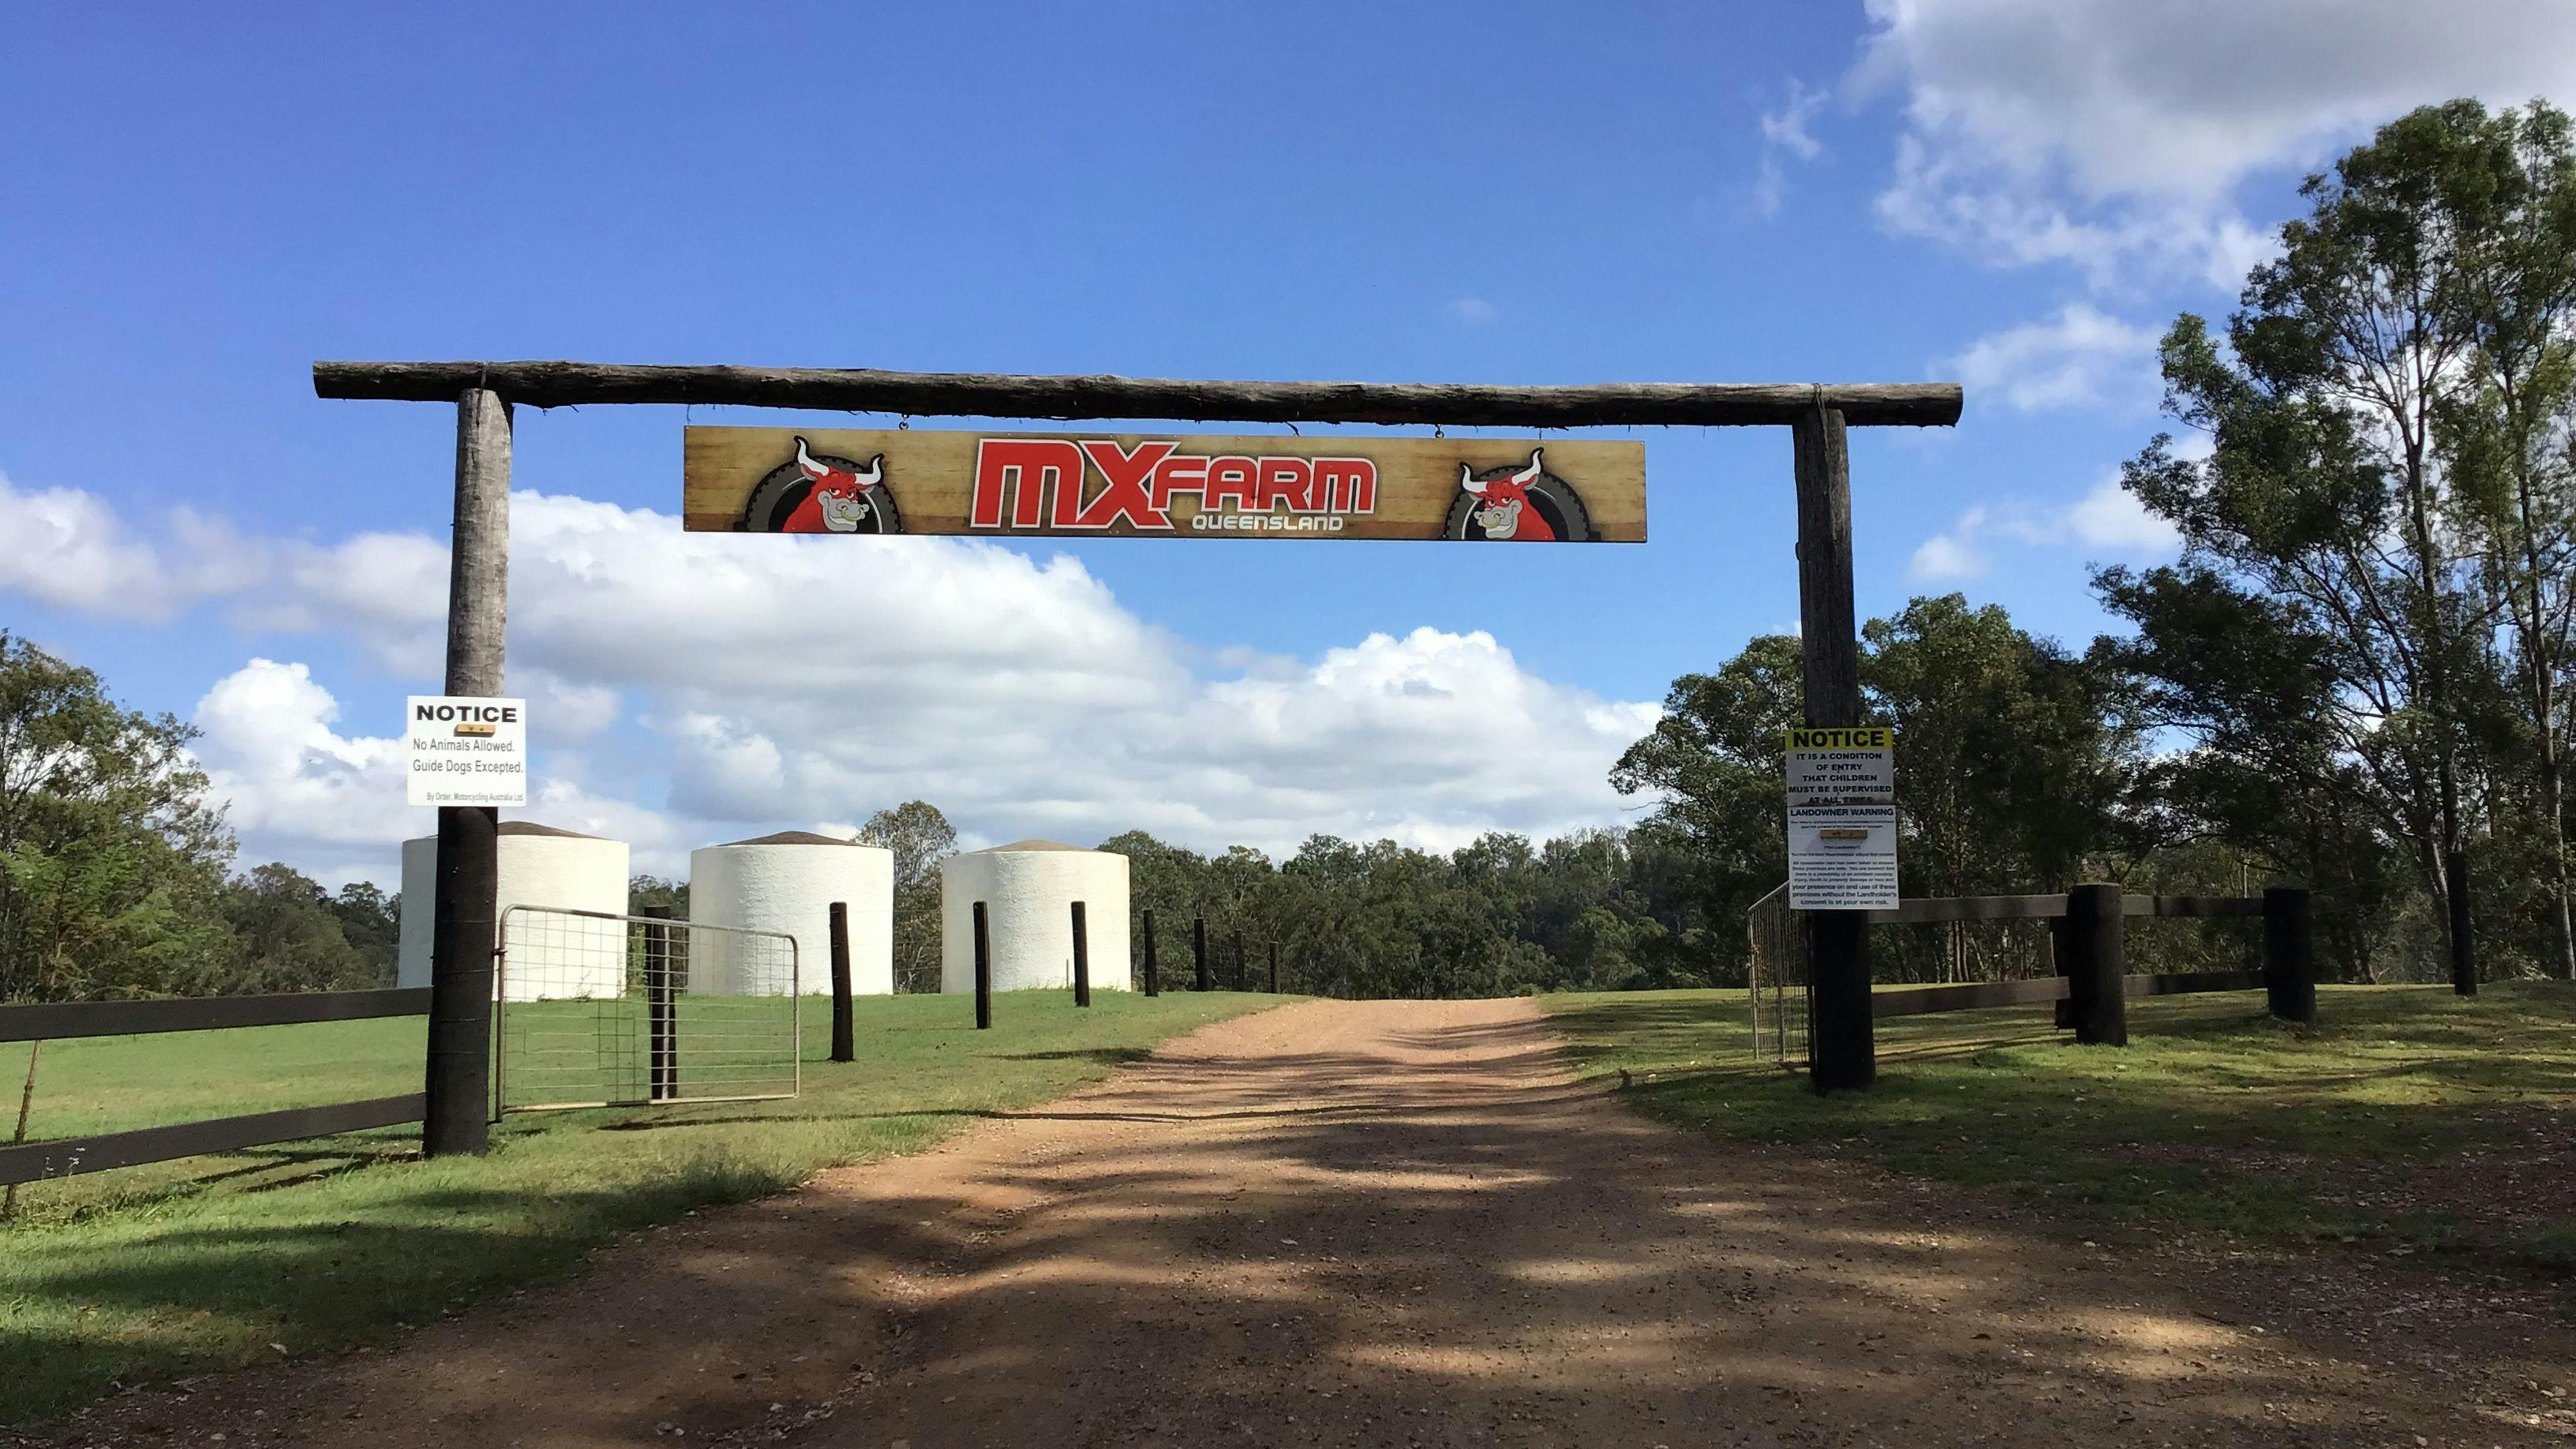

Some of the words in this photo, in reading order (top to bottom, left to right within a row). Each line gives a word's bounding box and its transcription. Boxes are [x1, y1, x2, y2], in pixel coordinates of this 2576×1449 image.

[1192, 515, 1343, 531] QUEENSLAND
[417, 705, 517, 722] NOTICE
[413, 738, 427, 751] No
[429, 739, 470, 751] Animals
[473, 739, 515, 752] Allowed.
[1793, 731, 1885, 747] NOTICE
[413, 759, 443, 771] Guide
[446, 759, 472, 775] Dogs
[475, 760, 523, 775] Excepted.
[427, 792, 435, 802] By
[453, 792, 488, 802] Motorcycling
[489, 793, 513, 801] Australia
[1790, 808, 1848, 816] LANDOWNER
[1851, 808, 1894, 816] WARNING
